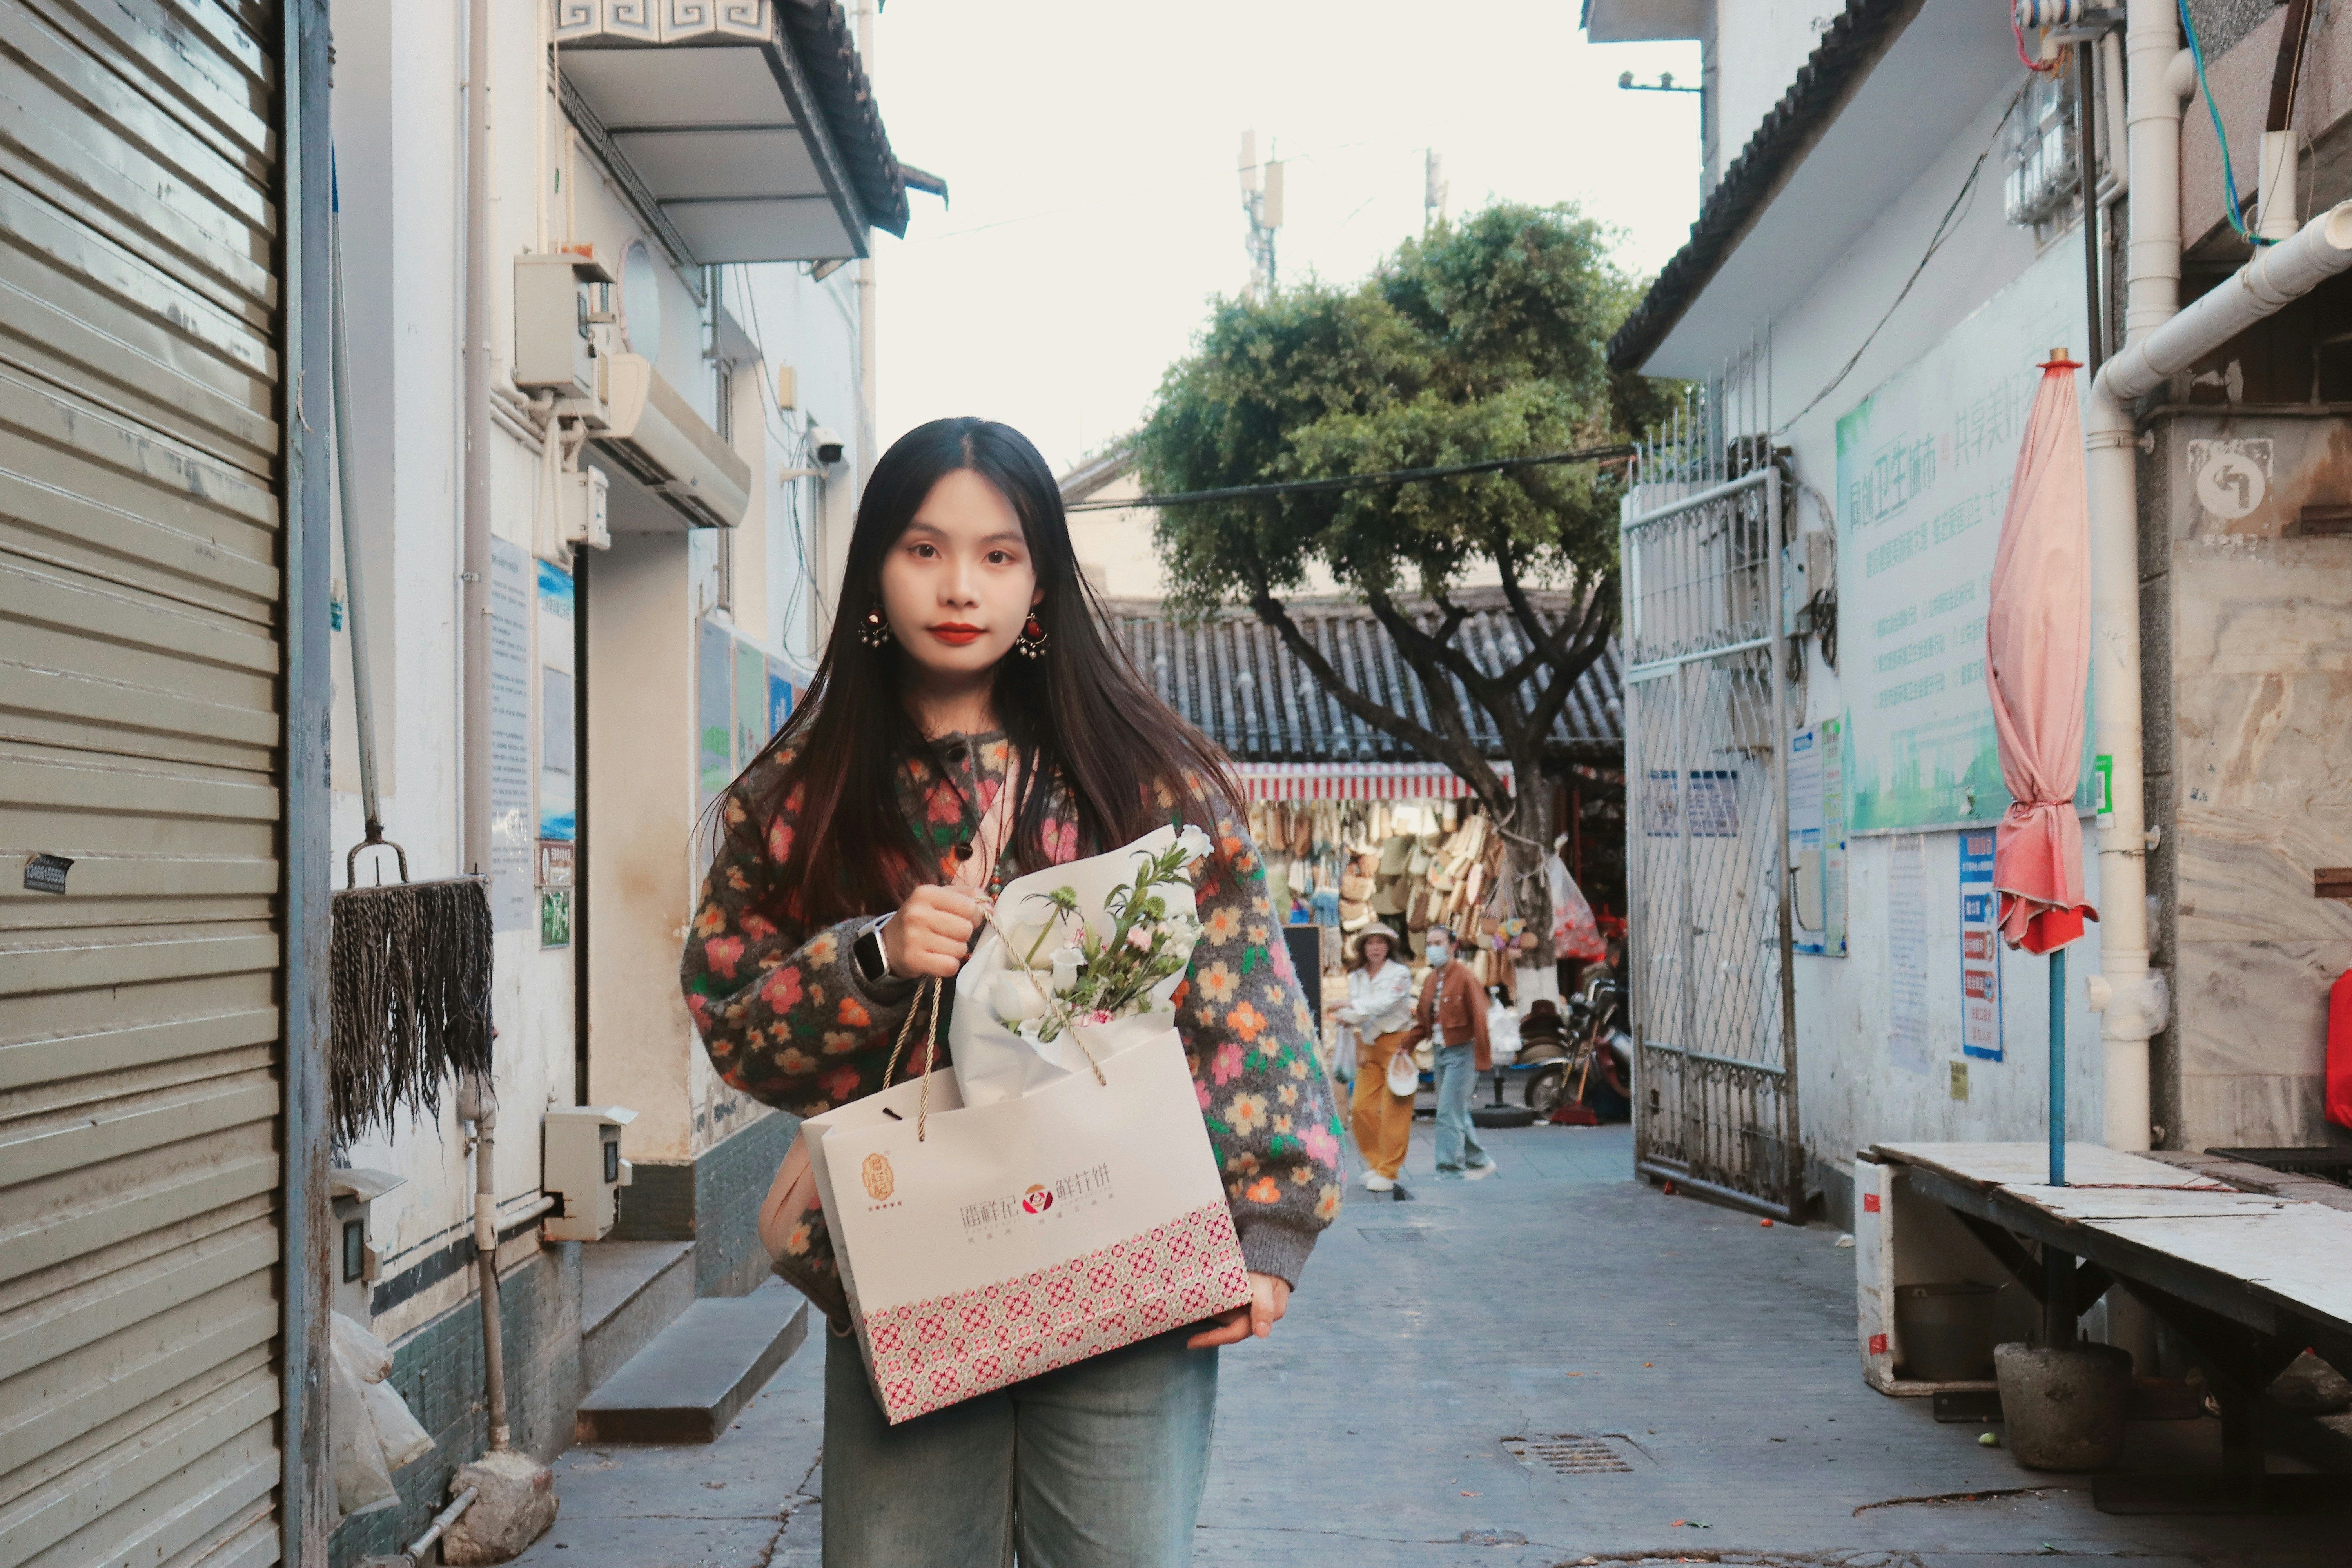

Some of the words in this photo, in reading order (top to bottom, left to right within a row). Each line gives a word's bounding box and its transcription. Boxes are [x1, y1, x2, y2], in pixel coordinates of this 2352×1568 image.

[1850, 432, 1936, 535] 同创卫生城市
[959, 1194, 1019, 1228] 潘祥记
[1055, 1162, 1110, 1200] 鲜花饼
